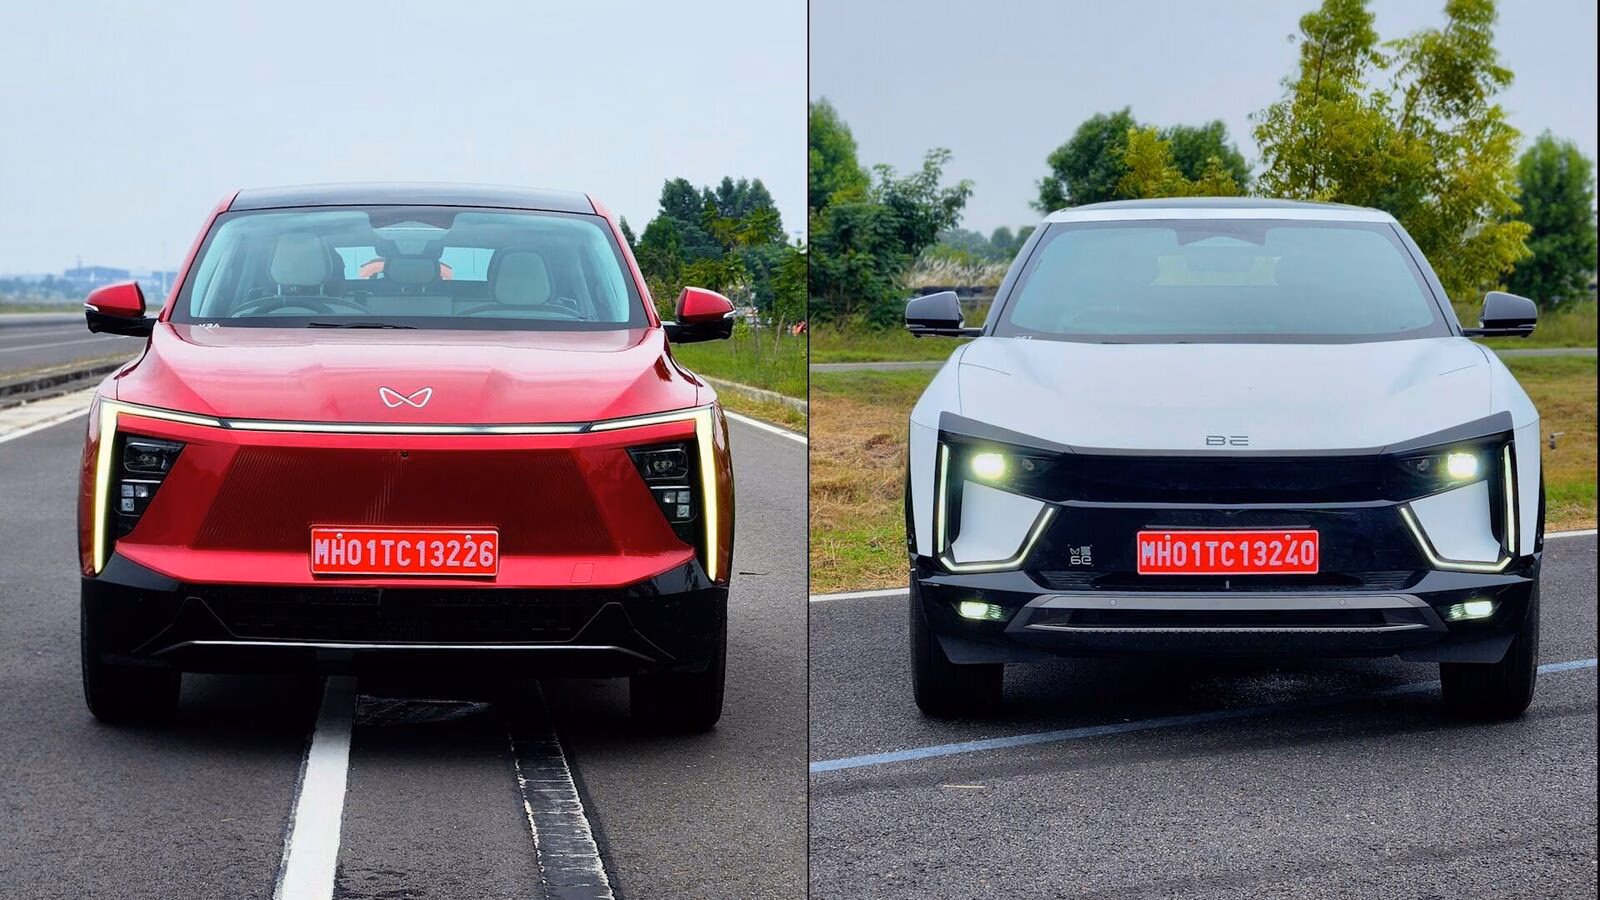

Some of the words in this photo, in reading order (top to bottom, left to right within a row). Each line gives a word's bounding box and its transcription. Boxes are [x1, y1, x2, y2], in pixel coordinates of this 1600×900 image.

[1206, 435, 1249, 446] BE
[314, 538, 494, 567] MH01TC13226
[1141, 540, 1315, 567] MH01TC13240
